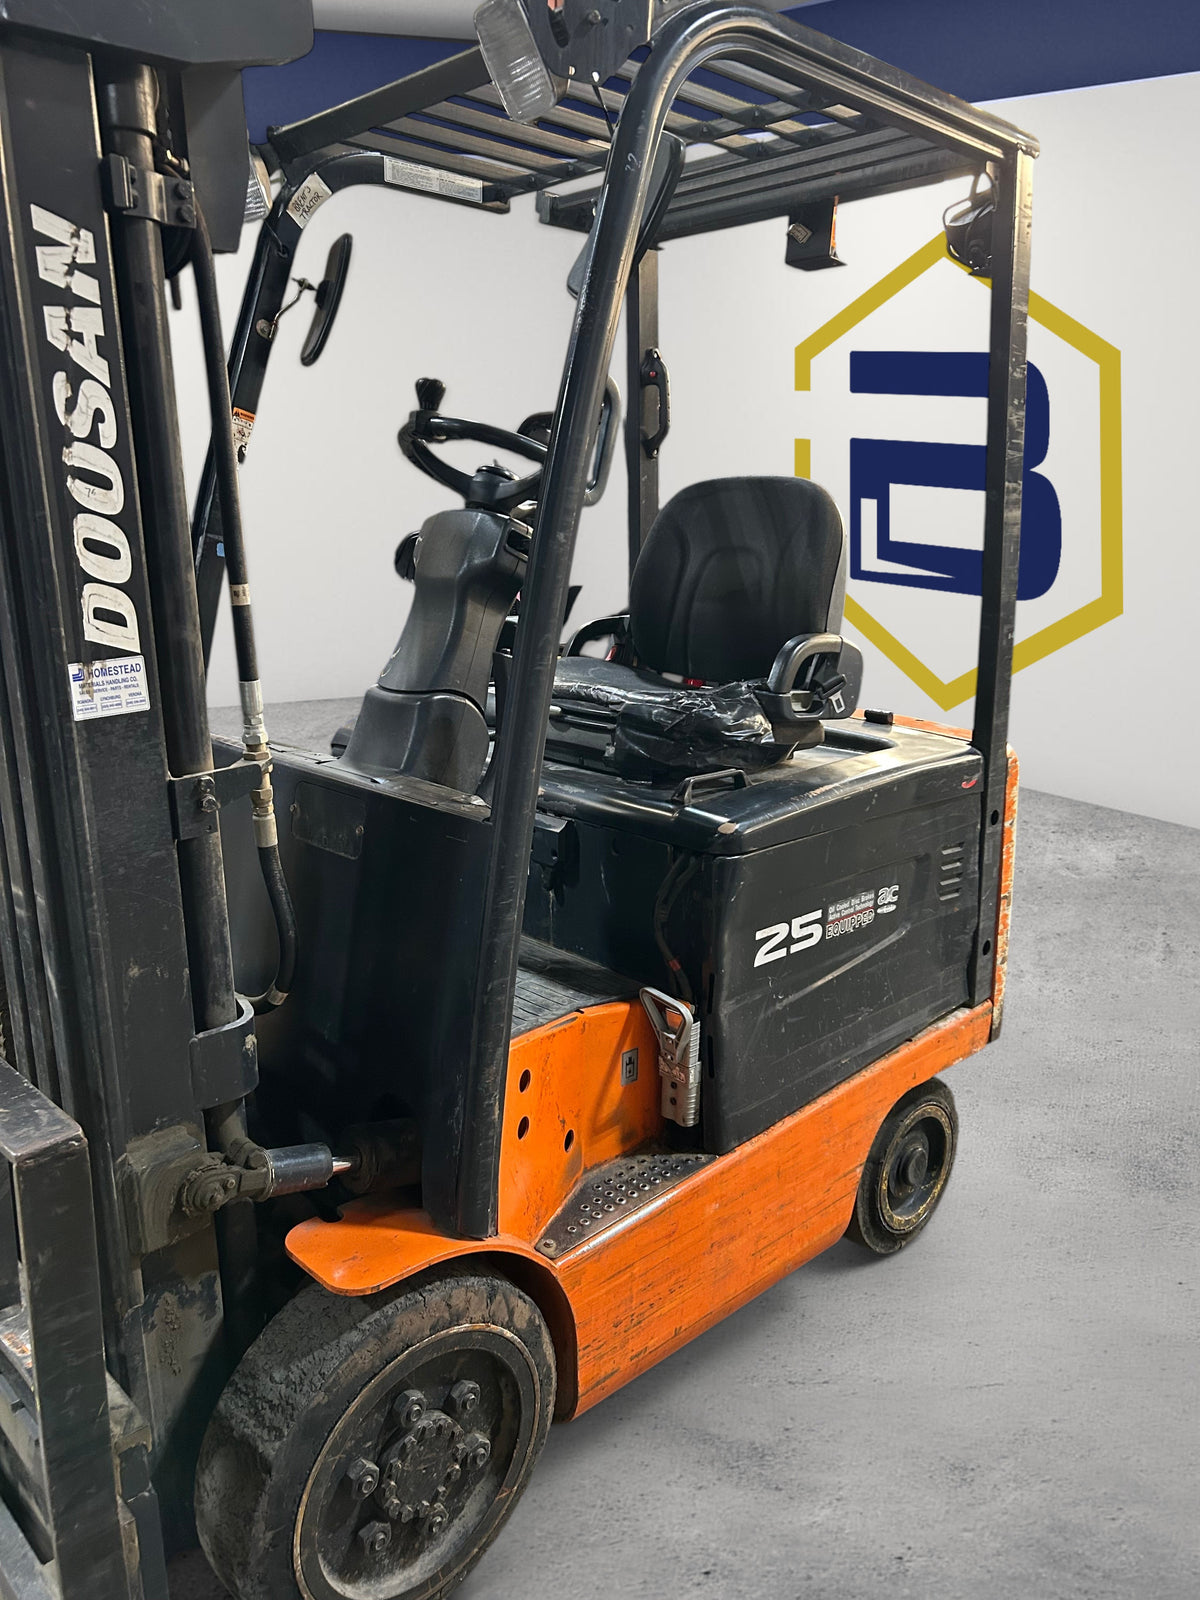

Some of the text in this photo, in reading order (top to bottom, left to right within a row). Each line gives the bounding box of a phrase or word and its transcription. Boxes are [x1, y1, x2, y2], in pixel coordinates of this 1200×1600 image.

[299, 191, 324, 219] TRACTOR
[30, 204, 142, 654] DOOSAN
[88, 662, 142, 678] HOMESTEAD
[106, 677, 130, 686] HANDLING
[753, 908, 823, 968] 25
[826, 909, 875, 939] EQUIPPED
